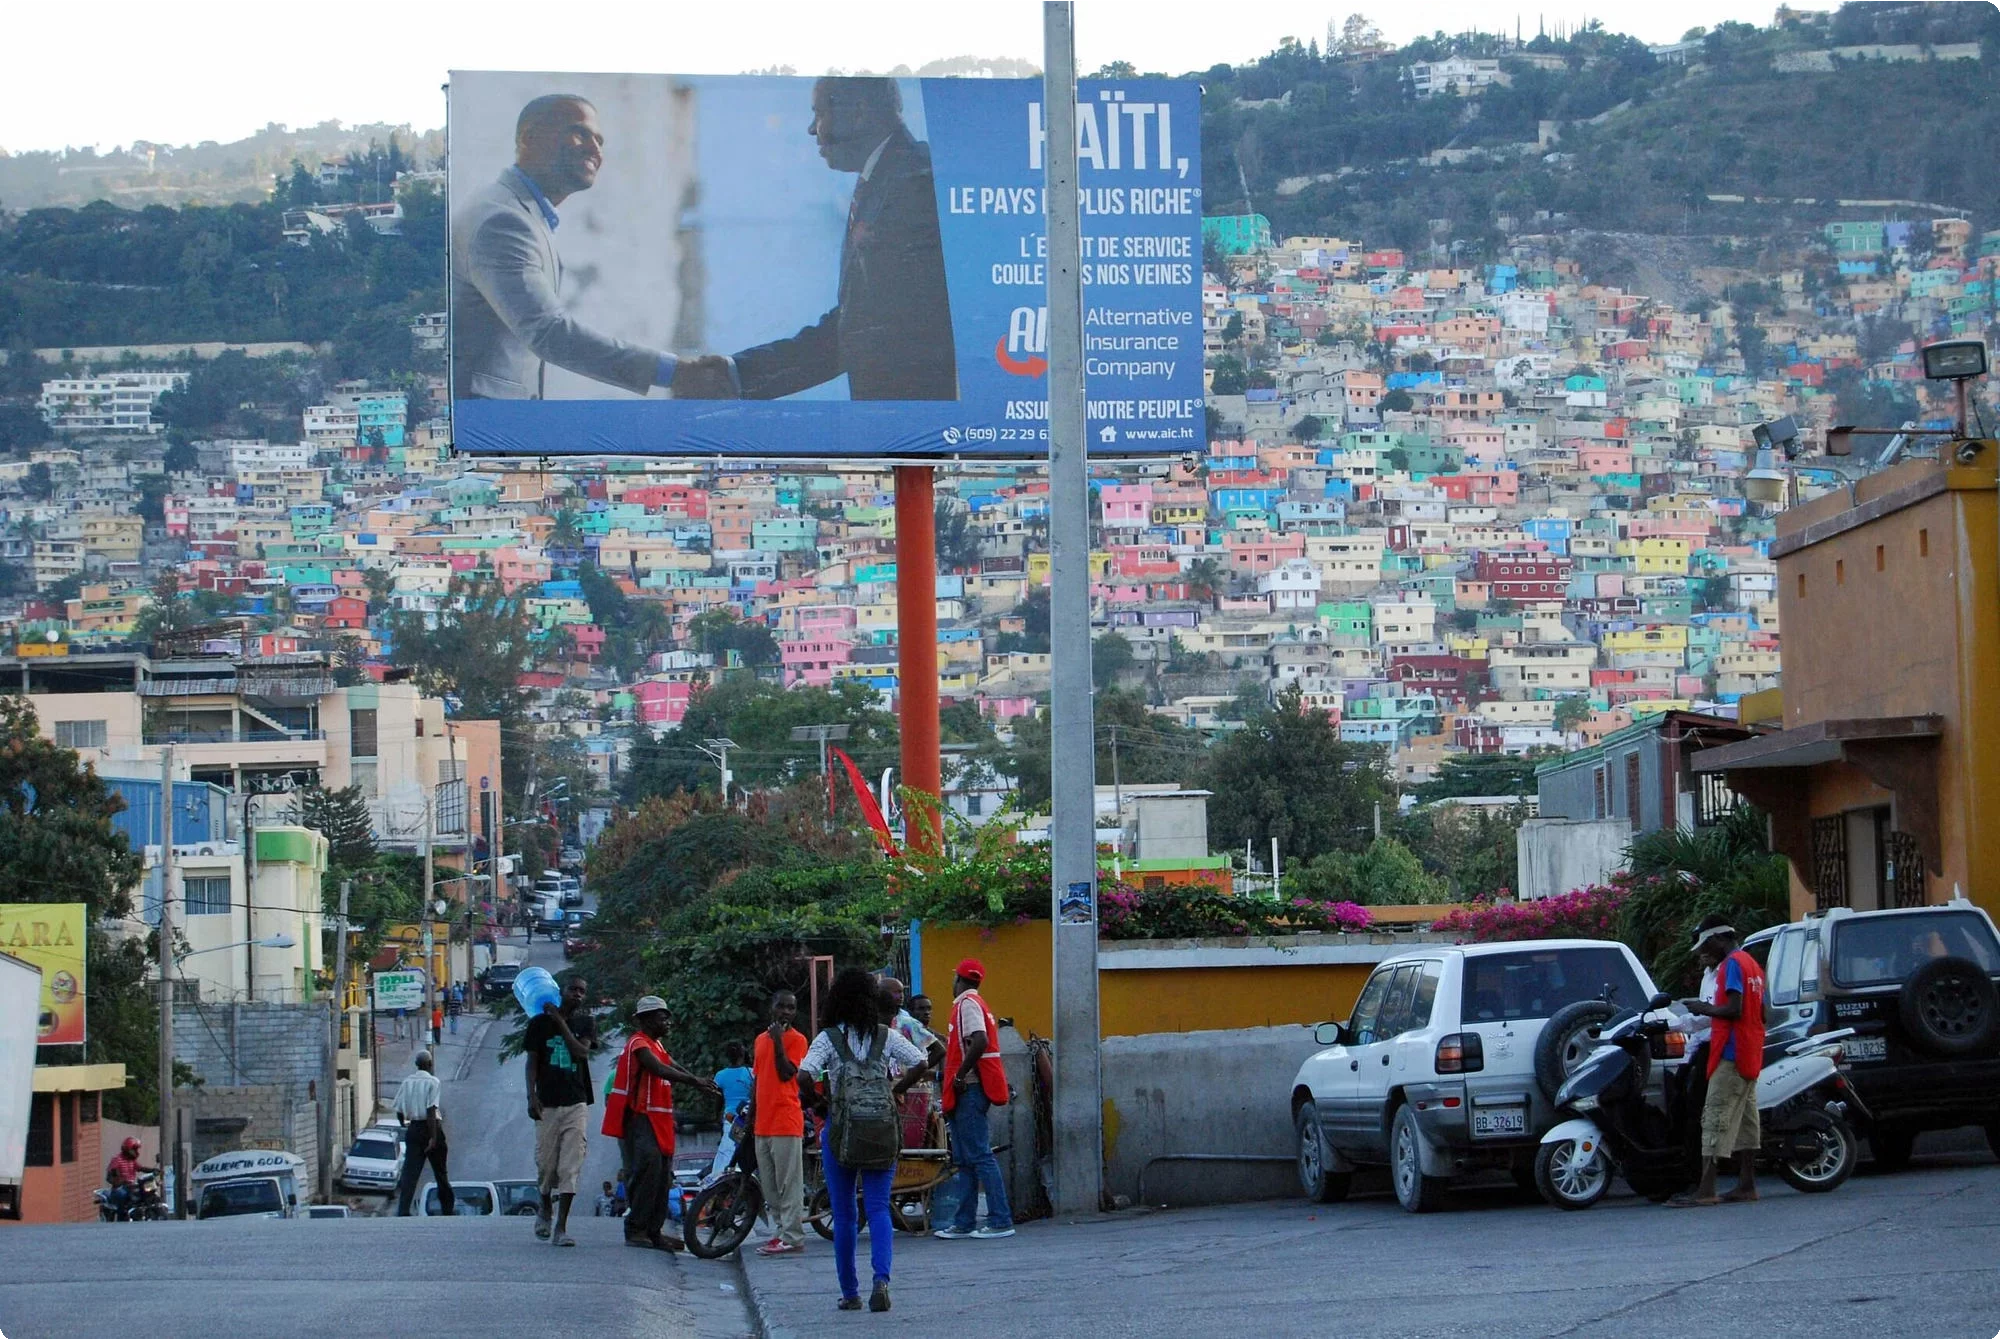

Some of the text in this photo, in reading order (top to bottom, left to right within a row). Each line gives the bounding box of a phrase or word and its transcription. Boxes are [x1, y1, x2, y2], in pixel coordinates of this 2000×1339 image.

[1028, 90, 1189, 179] HAÏTI,
[950, 187, 975, 213] LE
[981, 188, 1035, 214] PAYS
[1098, 237, 1118, 257] DE
[1123, 236, 1192, 257] SERVICE
[992, 264, 1044, 285] COULE
[1096, 264, 1130, 285] NOS
[1134, 264, 1192, 285] VEINES
[1086, 308, 1193, 325] Alternative
[1008, 307, 1047, 352] AI
[1086, 333, 1179, 350] Insurance
[1086, 358, 1175, 380] Company
[1087, 400, 1134, 419] NOTRE
[964, 427, 997, 441] (509)
[1000, 429, 1016, 440] 22
[1019, 429, 1035, 440] 29
[1125, 427, 1194, 440] www.aic.ht
[1476, 1115, 1523, 1129] BB-32619
[257, 1156, 283, 1167] GOD
